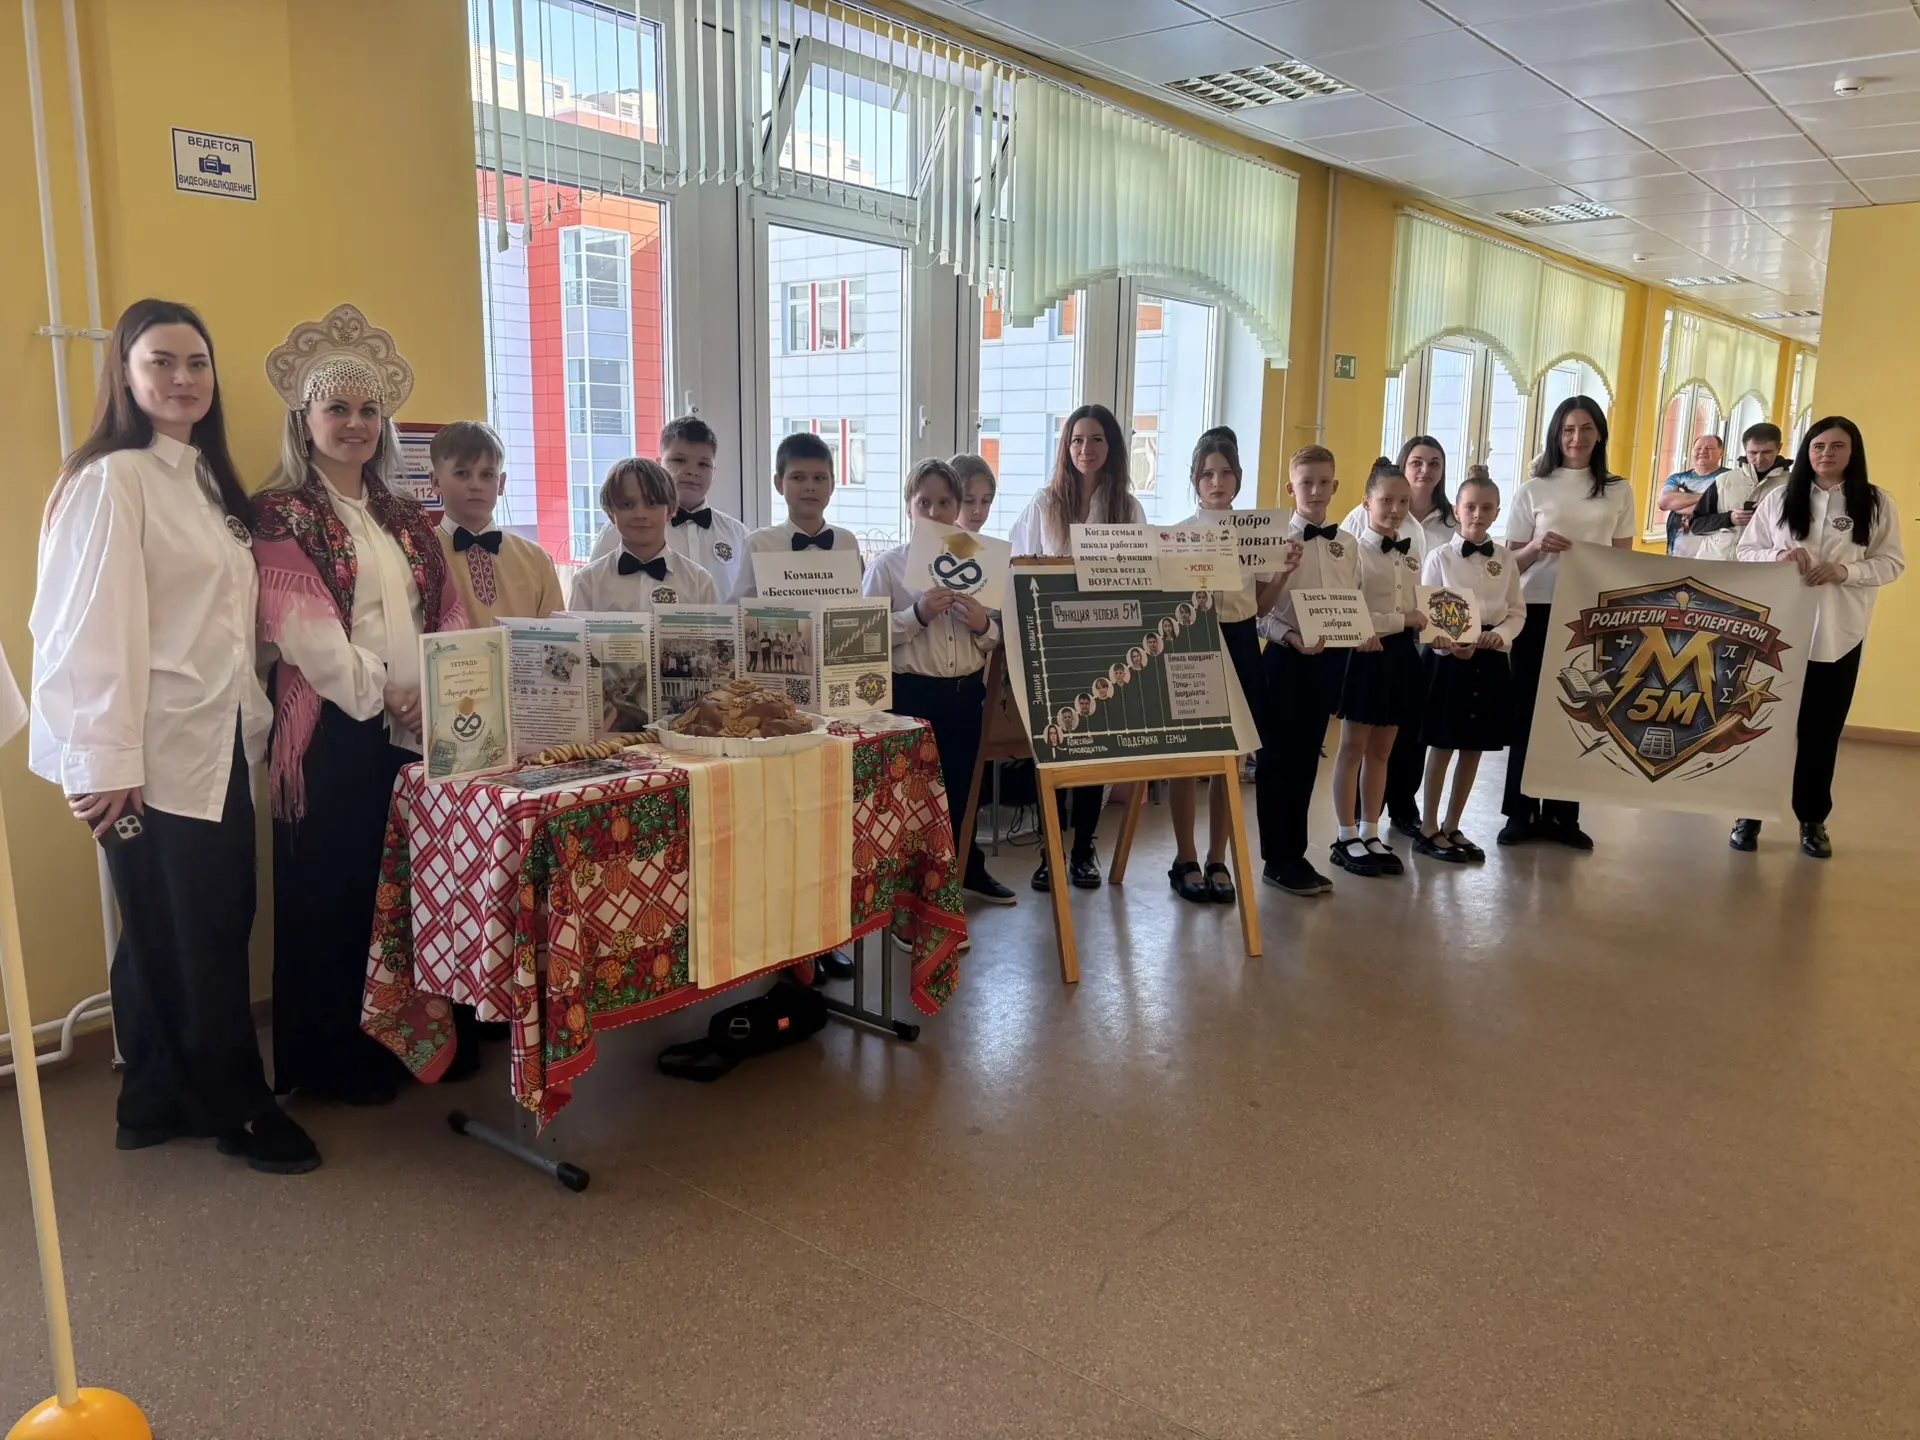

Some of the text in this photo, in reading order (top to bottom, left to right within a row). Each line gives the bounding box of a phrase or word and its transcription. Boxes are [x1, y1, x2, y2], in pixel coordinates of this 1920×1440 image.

[187, 136, 240, 153] ВЕДЕТСЯ
[178, 174, 252, 194] ВИДЕОНАБЛЮДЕНИЕ
[414, 488, 434, 498] 112
[1218, 514, 1271, 529] «Добро
[1085, 528, 1110, 536] Когда
[1110, 541, 1148, 551] работают
[1236, 536, 1287, 547] ловать
[1116, 553, 1153, 563] функция
[1238, 553, 1266, 566] М!»
[1091, 567, 1118, 576] успеха
[1190, 564, 1213, 572] УСПЕХ!
[784, 570, 833, 580] Команда
[1088, 578, 1152, 586] ВОЗРАСТАЕТ!
[762, 587, 859, 597] «Бесконечность»
[1301, 593, 1327, 602] Здесь
[1122, 602, 1140, 620] 5М
[1308, 607, 1341, 616] растут,
[1322, 619, 1352, 629] добрая
[1589, 610, 1667, 628] РОДИТЕЛИ
[1684, 612, 1768, 643] СУПЕРГЕРОИ
[451, 659, 478, 668] ТЕТРАДЬ
[1626, 687, 1704, 725] 5М
